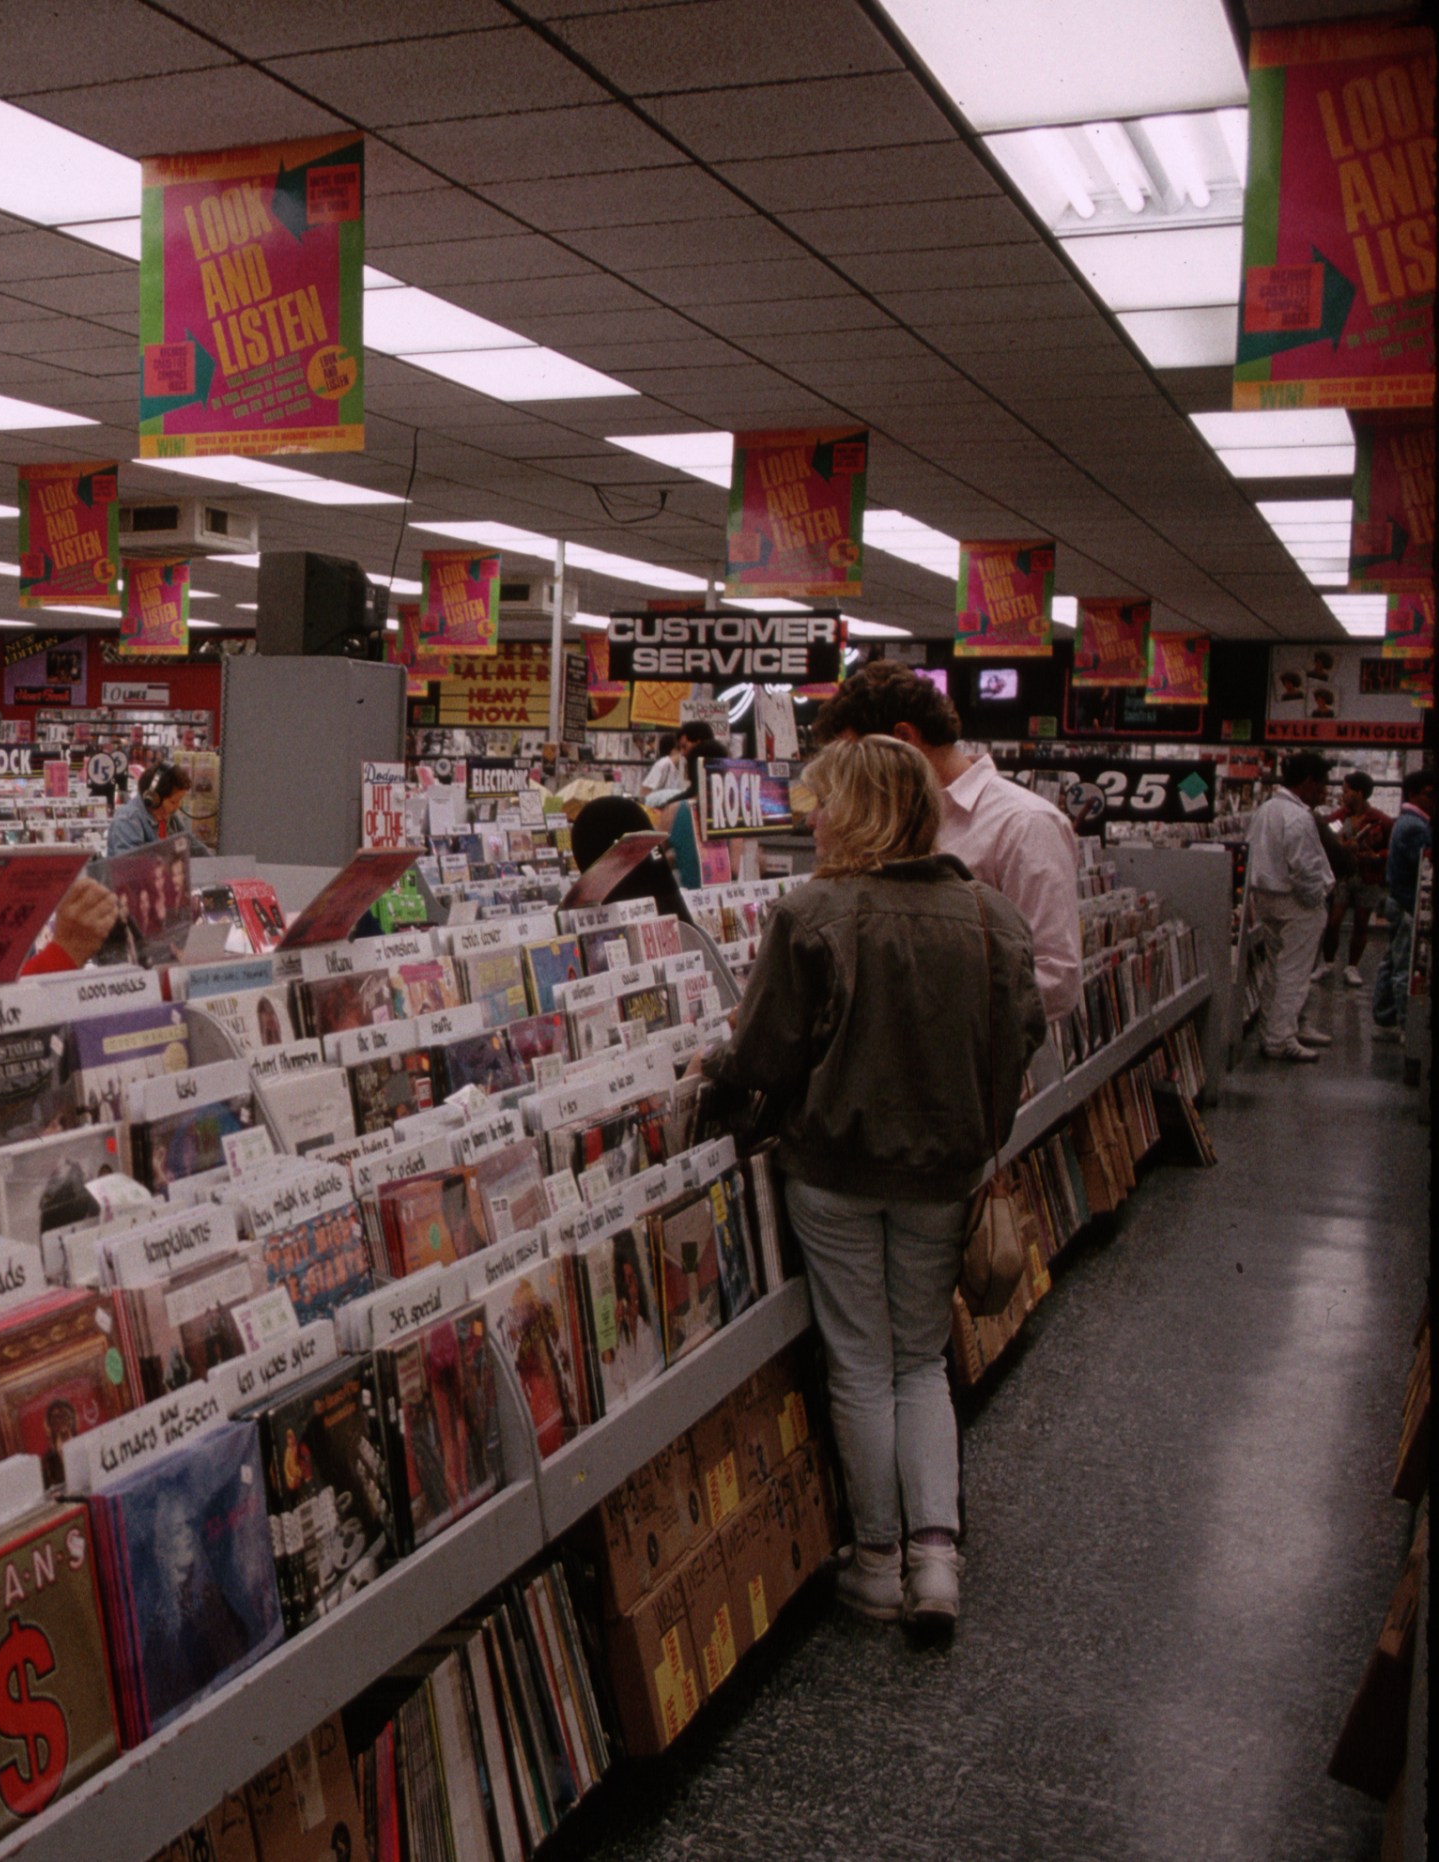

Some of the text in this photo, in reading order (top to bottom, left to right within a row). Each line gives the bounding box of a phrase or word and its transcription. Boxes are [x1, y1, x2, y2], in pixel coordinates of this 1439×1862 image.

[183, 181, 272, 260] LOOK
[201, 243, 272, 319] AND
[212, 285, 328, 376] LISTEN
[758, 445, 812, 490] LOOK
[38, 479, 79, 515] LOOK
[765, 482, 809, 521] AND
[46, 511, 78, 541] AND
[771, 506, 841, 551] LISTEN
[50, 528, 103, 569] LISTEN
[436, 564, 469, 586] LOOK
[977, 550, 1017, 582] LOOK
[139, 587, 161, 614] AND
[441, 582, 467, 605] AND
[983, 574, 1014, 601] AND
[142, 602, 177, 630] LISTEN
[445, 599, 485, 625] LISTEN
[988, 593, 1038, 626] LISTEN
[608, 617, 836, 644] CUSTOMER
[3, 636, 58, 666] EDITION
[632, 648, 809, 675] SERVICE
[468, 687, 530, 705] HEAVY
[468, 706, 530, 723] NOVA
[1268, 722, 1421, 740] KYLIE MINOGUE
[93, 756, 110, 782] 15
[472, 767, 530, 793] ELECTRONIC
[372, 785, 392, 811] HIT
[710, 771, 764, 829] ROCK
[1094, 770, 1171, 810] 25
[365, 810, 404, 837] OF THE
[143, 1217, 212, 1263] temptations
[410, 1285, 442, 1324] special
[237, 1370, 255, 1396] ten
